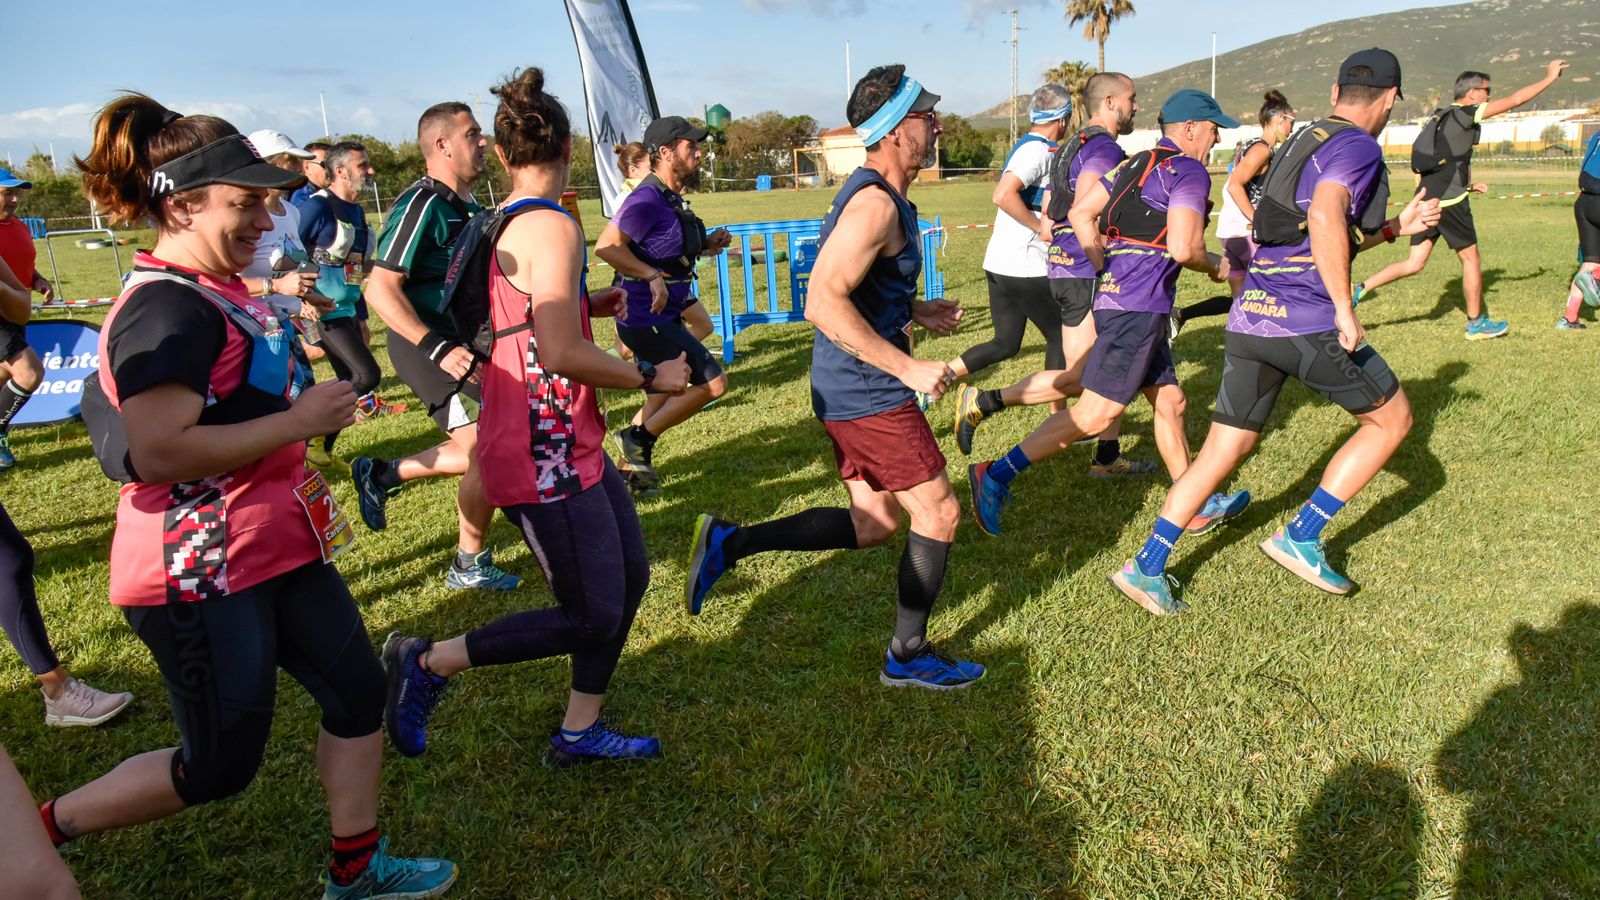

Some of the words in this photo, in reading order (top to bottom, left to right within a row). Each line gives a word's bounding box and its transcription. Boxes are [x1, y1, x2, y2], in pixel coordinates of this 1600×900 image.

[1265, 296, 1277, 304] SE
[1240, 301, 1288, 318] ANDARA
[43, 352, 99, 370] iento
[33, 380, 83, 395] nea
